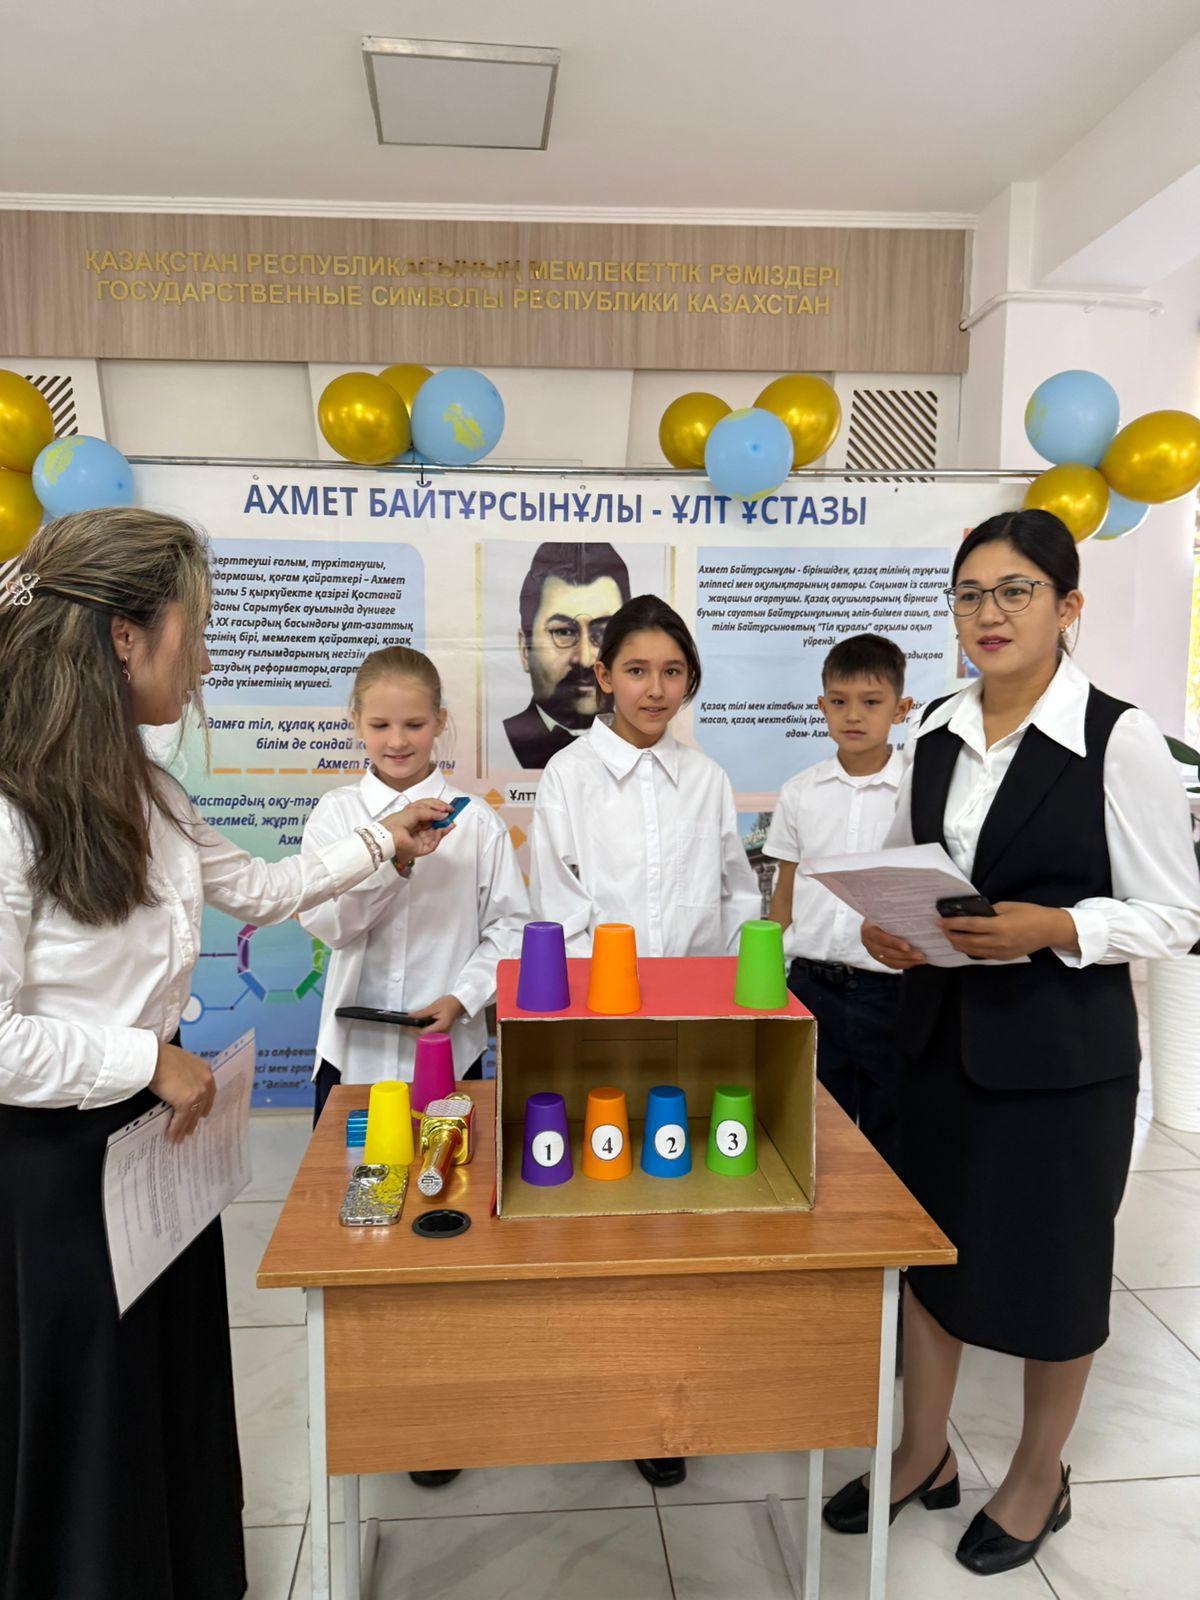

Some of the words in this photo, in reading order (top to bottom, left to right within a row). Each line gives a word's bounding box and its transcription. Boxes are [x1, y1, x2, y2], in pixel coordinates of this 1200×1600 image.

[84, 249, 238, 277] ҚАЗАҚСТАН
[529, 259, 702, 284] МЕМЛЕКЕТТІК
[709, 263, 841, 289] РӘМІЗДЕРІ
[96, 280, 362, 306] ГОСУДАРСТВЕННЫЕ
[371, 285, 504, 309] СИМВОЛЫ
[513, 288, 679, 313] РЕСПУБЛИКИ
[686, 293, 831, 315] КАЗАХСТАН
[243, 484, 358, 517] АХМЕТ
[368, 480, 642, 523] БАЙТҰРСЫНҰЛЫ
[670, 494, 731, 525] ҰЛТ
[741, 495, 867, 526] ҰСТАЗЫ
[273, 558, 309, 568] ғалым,
[311, 557, 386, 571] түркітанушы,
[699, 564, 728, 575] Ахмет
[729, 564, 796, 576] Байтұрсынұлы
[802, 565, 851, 577] біріншіден,
[852, 566, 879, 577] қазақ
[878, 565, 911, 577] тілінің
[911, 567, 950, 577] тұңғыш
[268, 573, 300, 584] қоғам
[302, 573, 362, 586] қайраткері
[370, 574, 406, 585] Ахмет
[699, 579, 734, 590] әліппесі
[735, 581, 753, 589] мен
[754, 581, 829, 592] оқулықтарының
[830, 582, 867, 592] авторы.
[869, 580, 908, 591] Соңынан
[918, 580, 949, 590] салған
[213, 587, 239, 597] ылы
[240, 586, 247, 596] 5
[248, 587, 313, 600] қыркүйекте
[314, 588, 349, 601] қазіргі
[351, 589, 402, 601] Қостанай
[708, 595, 753, 605] жаңашыл
[753, 596, 802, 606] ағартушы.
[803, 595, 830, 605] Қазақ
[831, 596, 901, 606] оқушыларының
[902, 593, 939, 605] бірнеше
[242, 602, 301, 615] Сарытүбек
[303, 603, 355, 616] ауылында
[356, 604, 396, 617] дүниеге
[696, 607, 725, 619] буыны
[726, 610, 766, 619] сауатын
[766, 608, 851, 620] Байтұрсынұлының
[903, 610, 931, 618] ашып,
[231, 617, 282, 630] ғасырдың
[284, 618, 339, 630] басындағы
[341, 620, 414, 632] ұлт-азаттық
[711, 621, 736, 632] тілін
[737, 622, 816, 633] Байтұрсыновтың
[873, 624, 908, 633] арқылы
[909, 625, 932, 633] оқып
[204, 631, 237, 644] ерінің
[239, 631, 260, 645] бірі,
[261, 634, 316, 644] мемлекет
[318, 633, 380, 647] қайраткері,
[382, 636, 413, 647] қазақ
[208, 648, 247, 660] ттану
[247, 648, 330, 661] ғылымдарының
[331, 648, 366, 660] негізін
[236, 677, 292, 690] үкіметінің
[293, 678, 333, 690] мүшесі.
[700, 701, 726, 711] Қазақ
[728, 701, 747, 710] тілі
[766, 702, 804, 711] кітабын
[248, 717, 274, 732] тіл,
[277, 719, 315, 734] құлақ
[317, 718, 355, 734] қанда
[699, 717, 729, 725] жасап,
[730, 717, 756, 725] қазақ
[757, 715, 807, 725] мектебінің
[807, 714, 828, 725] ірге
[811, 729, 829, 738] Ахм
[256, 737, 289, 751] білім
[291, 737, 307, 750] де
[309, 738, 353, 752] сондай
[317, 757, 360, 770] Ахмет
[267, 796, 320, 810] оқу-тәр
[260, 816, 298, 829] жұрт
[278, 834, 302, 846] Ахм
[601, 1136, 614, 1154] 4
[666, 1136, 678, 1154] 2
[727, 1132, 739, 1151] 3
[544, 1143, 552, 1161] 1
